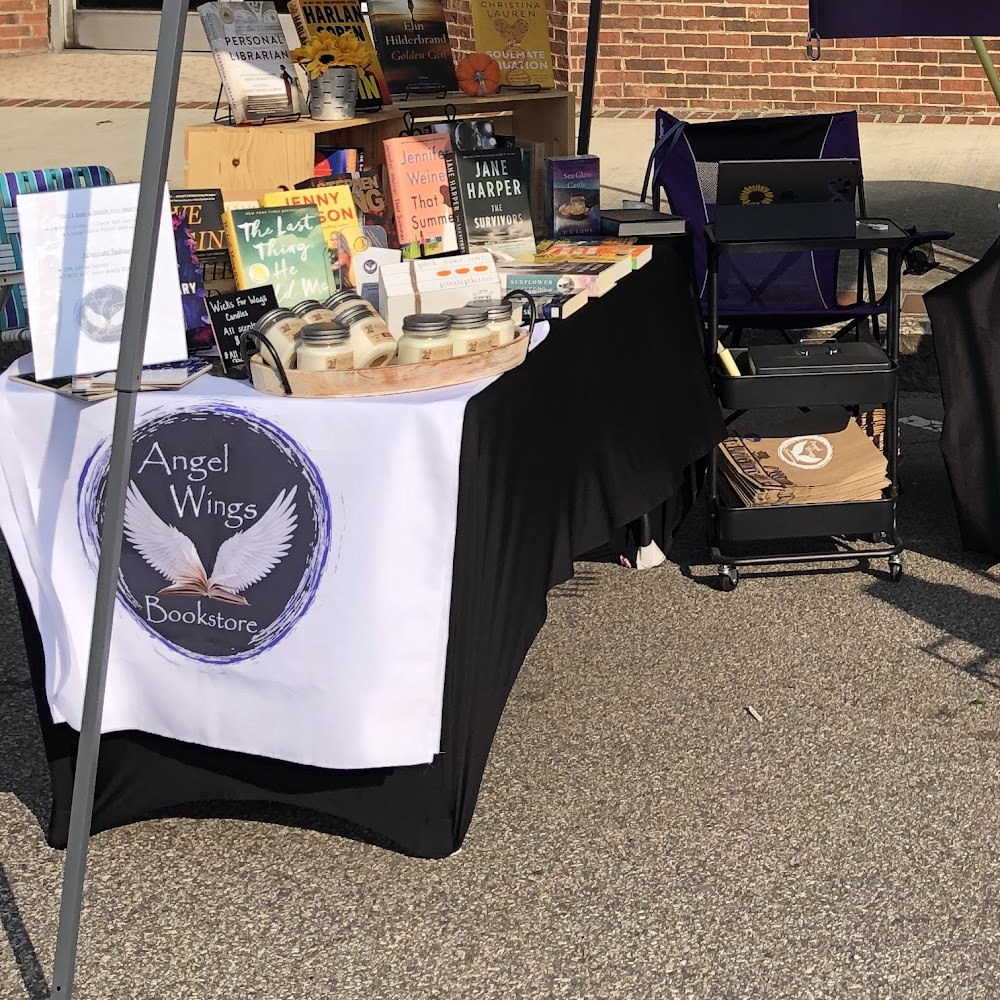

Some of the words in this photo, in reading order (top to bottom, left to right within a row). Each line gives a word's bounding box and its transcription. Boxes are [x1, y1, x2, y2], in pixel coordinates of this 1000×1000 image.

[480, 1, 541, 9] CHRISTINA
[302, 5, 365, 24] HARLAN
[488, 10, 536, 18] LAUREN
[404, 22, 424, 31] Elin
[225, 36, 284, 45] PERSONAL
[385, 36, 447, 46] Hilderbrand
[230, 50, 289, 60] LIBRARIAN
[391, 51, 425, 60] Golden
[428, 51, 447, 60] Girl
[485, 50, 545, 59] SOULMATE
[445, 158, 455, 178] JANE
[475, 160, 508, 178] JANE
[407, 170, 445, 185] Weine
[449, 180, 460, 212] HARPER
[466, 179, 522, 199] HARPER
[285, 192, 339, 206] JENNY
[412, 196, 438, 210] That
[491, 204, 502, 212] THE
[237, 219, 274, 242] The
[277, 213, 317, 237] Last
[412, 214, 455, 230] Summe
[474, 214, 522, 229] SURVIVORS
[253, 242, 310, 261] Thing
[273, 258, 298, 280] He
[417, 260, 437, 269] pick
[443, 257, 463, 266] your
[468, 254, 488, 263] own
[302, 277, 329, 297] Me
[439, 275, 493, 289] pumpkins
[209, 300, 234, 313] Wicks
[236, 297, 246, 306] For
[248, 295, 267, 306] Wags
[225, 310, 249, 321] Candles
[224, 327, 235, 336] All
[137, 441, 229, 482] Angel
[169, 484, 258, 528] Wings
[145, 595, 258, 634] Bookstore
